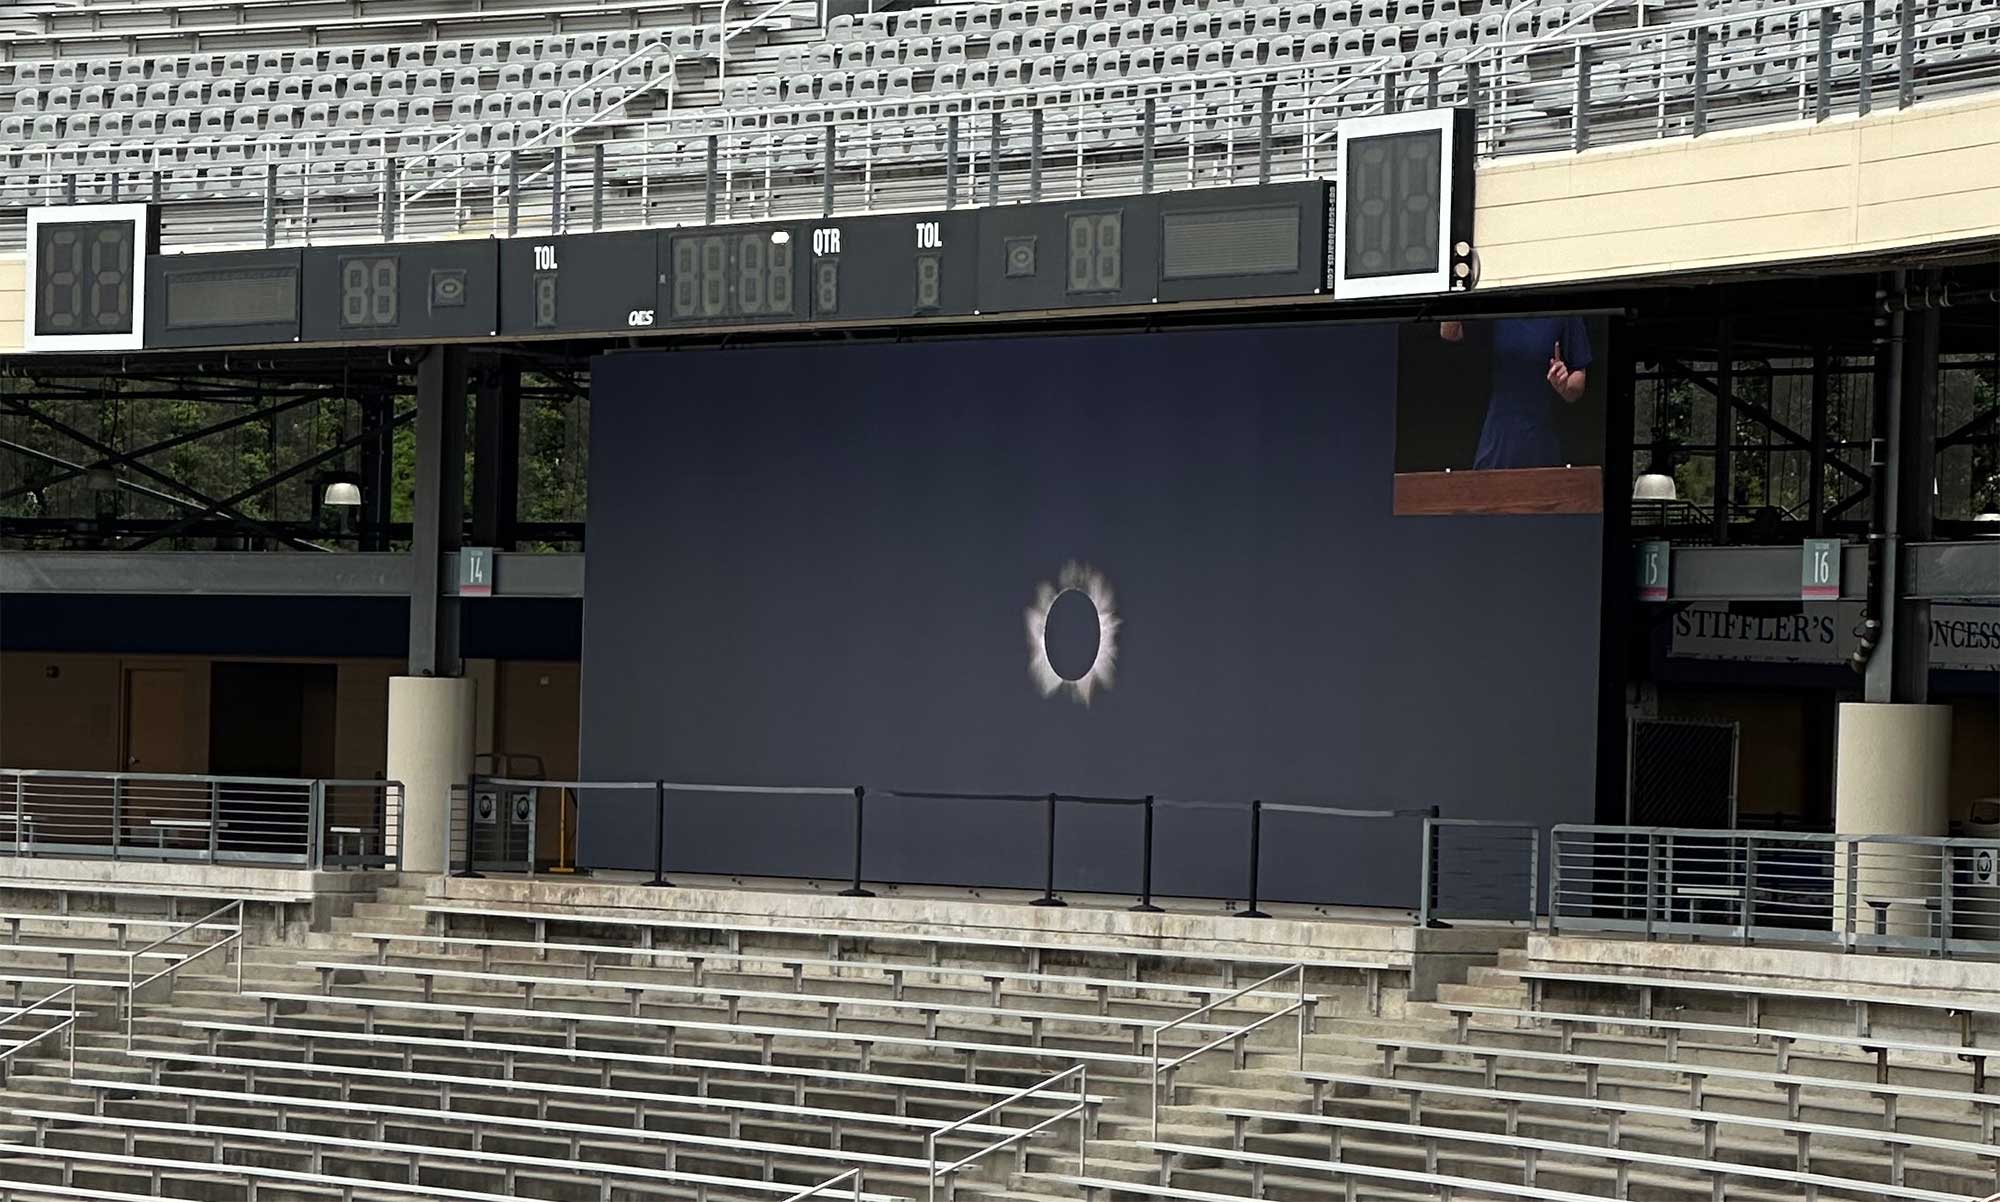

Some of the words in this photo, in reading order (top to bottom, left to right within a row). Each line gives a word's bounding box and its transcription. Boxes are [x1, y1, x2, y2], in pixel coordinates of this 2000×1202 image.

[813, 228, 841, 257] QTR
[915, 222, 943, 248] TOL
[534, 245, 558, 270] TOL
[628, 310, 655, 326] OES
[470, 556, 483, 583] 14
[1645, 553, 1658, 585] 15
[1814, 551, 1829, 584] 16
[1928, 619, 2000, 650] NCESS
